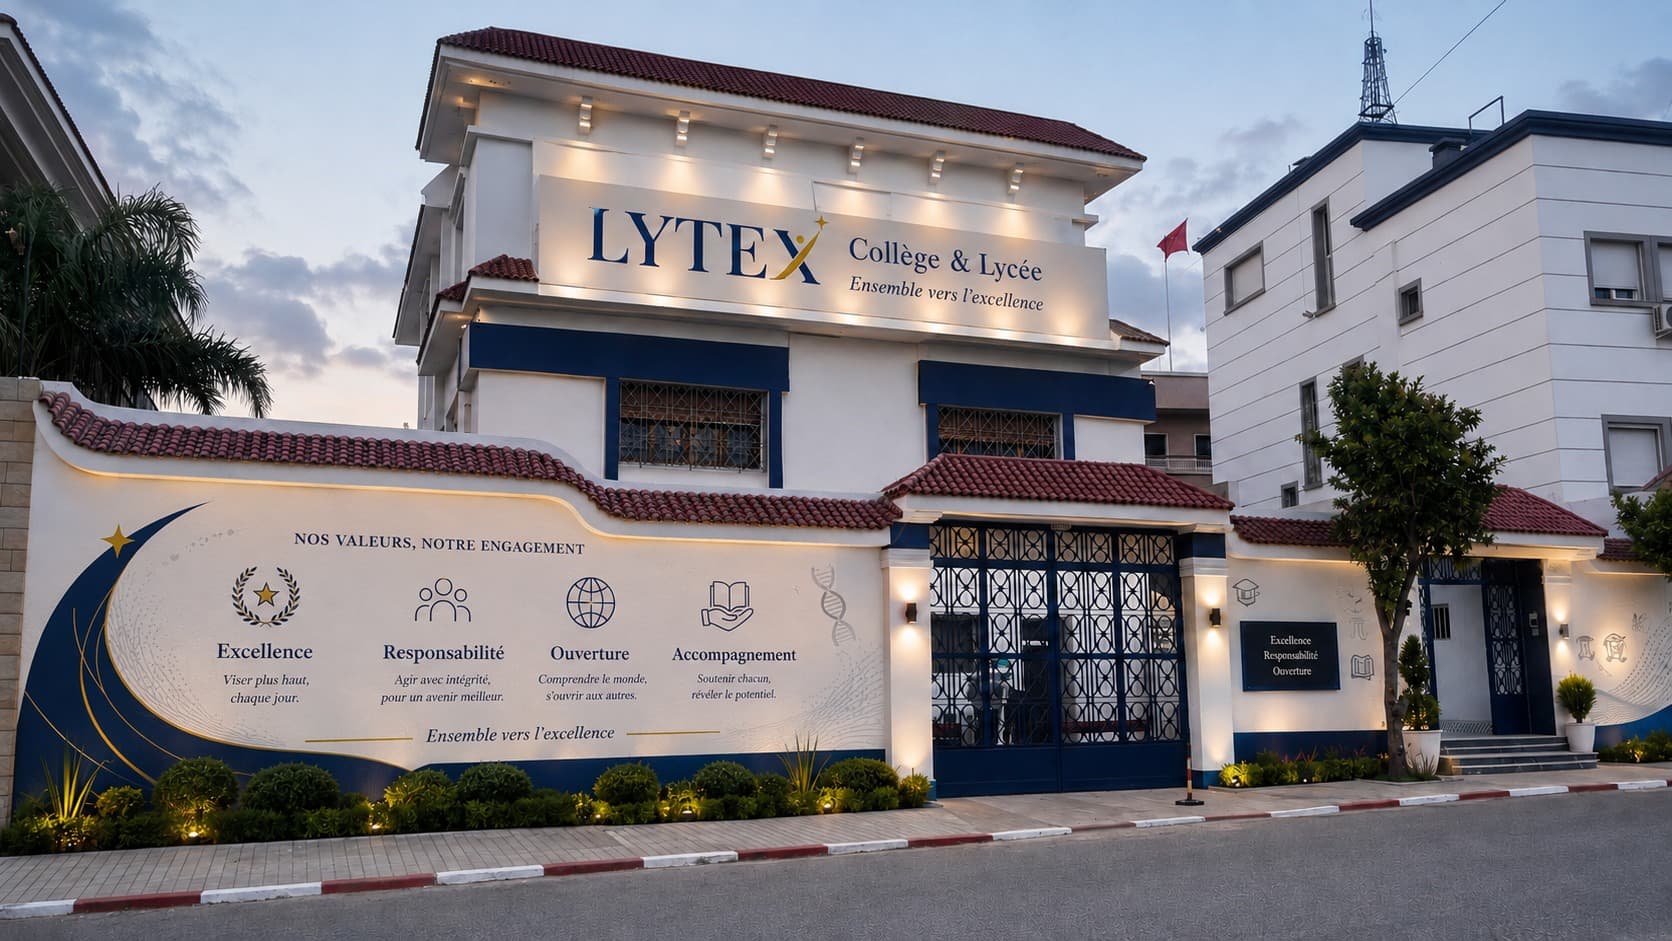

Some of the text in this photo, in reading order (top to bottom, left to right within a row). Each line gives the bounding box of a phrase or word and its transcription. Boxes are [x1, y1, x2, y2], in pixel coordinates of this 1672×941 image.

[588, 207, 823, 285] LYTEX
[850, 238, 1042, 282] Collège & Lycée
[849, 276, 1043, 311] Ensemble vers l’excellence
[294, 532, 585, 555] NOS VALEURS, NOTRE ENGAGEMENT
[1270, 635, 1312, 646] Excellence
[216, 642, 313, 660] Excellence
[383, 644, 505, 665] Responsabilité
[550, 645, 630, 661] Ouverture
[671, 647, 797, 665] Accompagnement
[1263, 650, 1319, 663] Responsabilité
[696, 672, 772, 685] Soutenir chacun,
[1272, 666, 1312, 676] Ouverture
[223, 673, 310, 689] Viser plus haut,
[394, 673, 491, 688] Agir avec intégrité,
[538, 673, 648, 688] Comprendre le monde,
[230, 690, 300, 706] chaque jour.
[380, 690, 504, 706] pour un avenir meilleur.
[545, 690, 637, 702] s’ouvrir aux autres.
[691, 688, 777, 703] révéler le potentiel.
[425, 725, 615, 743] Ensemble vers l’excellence
